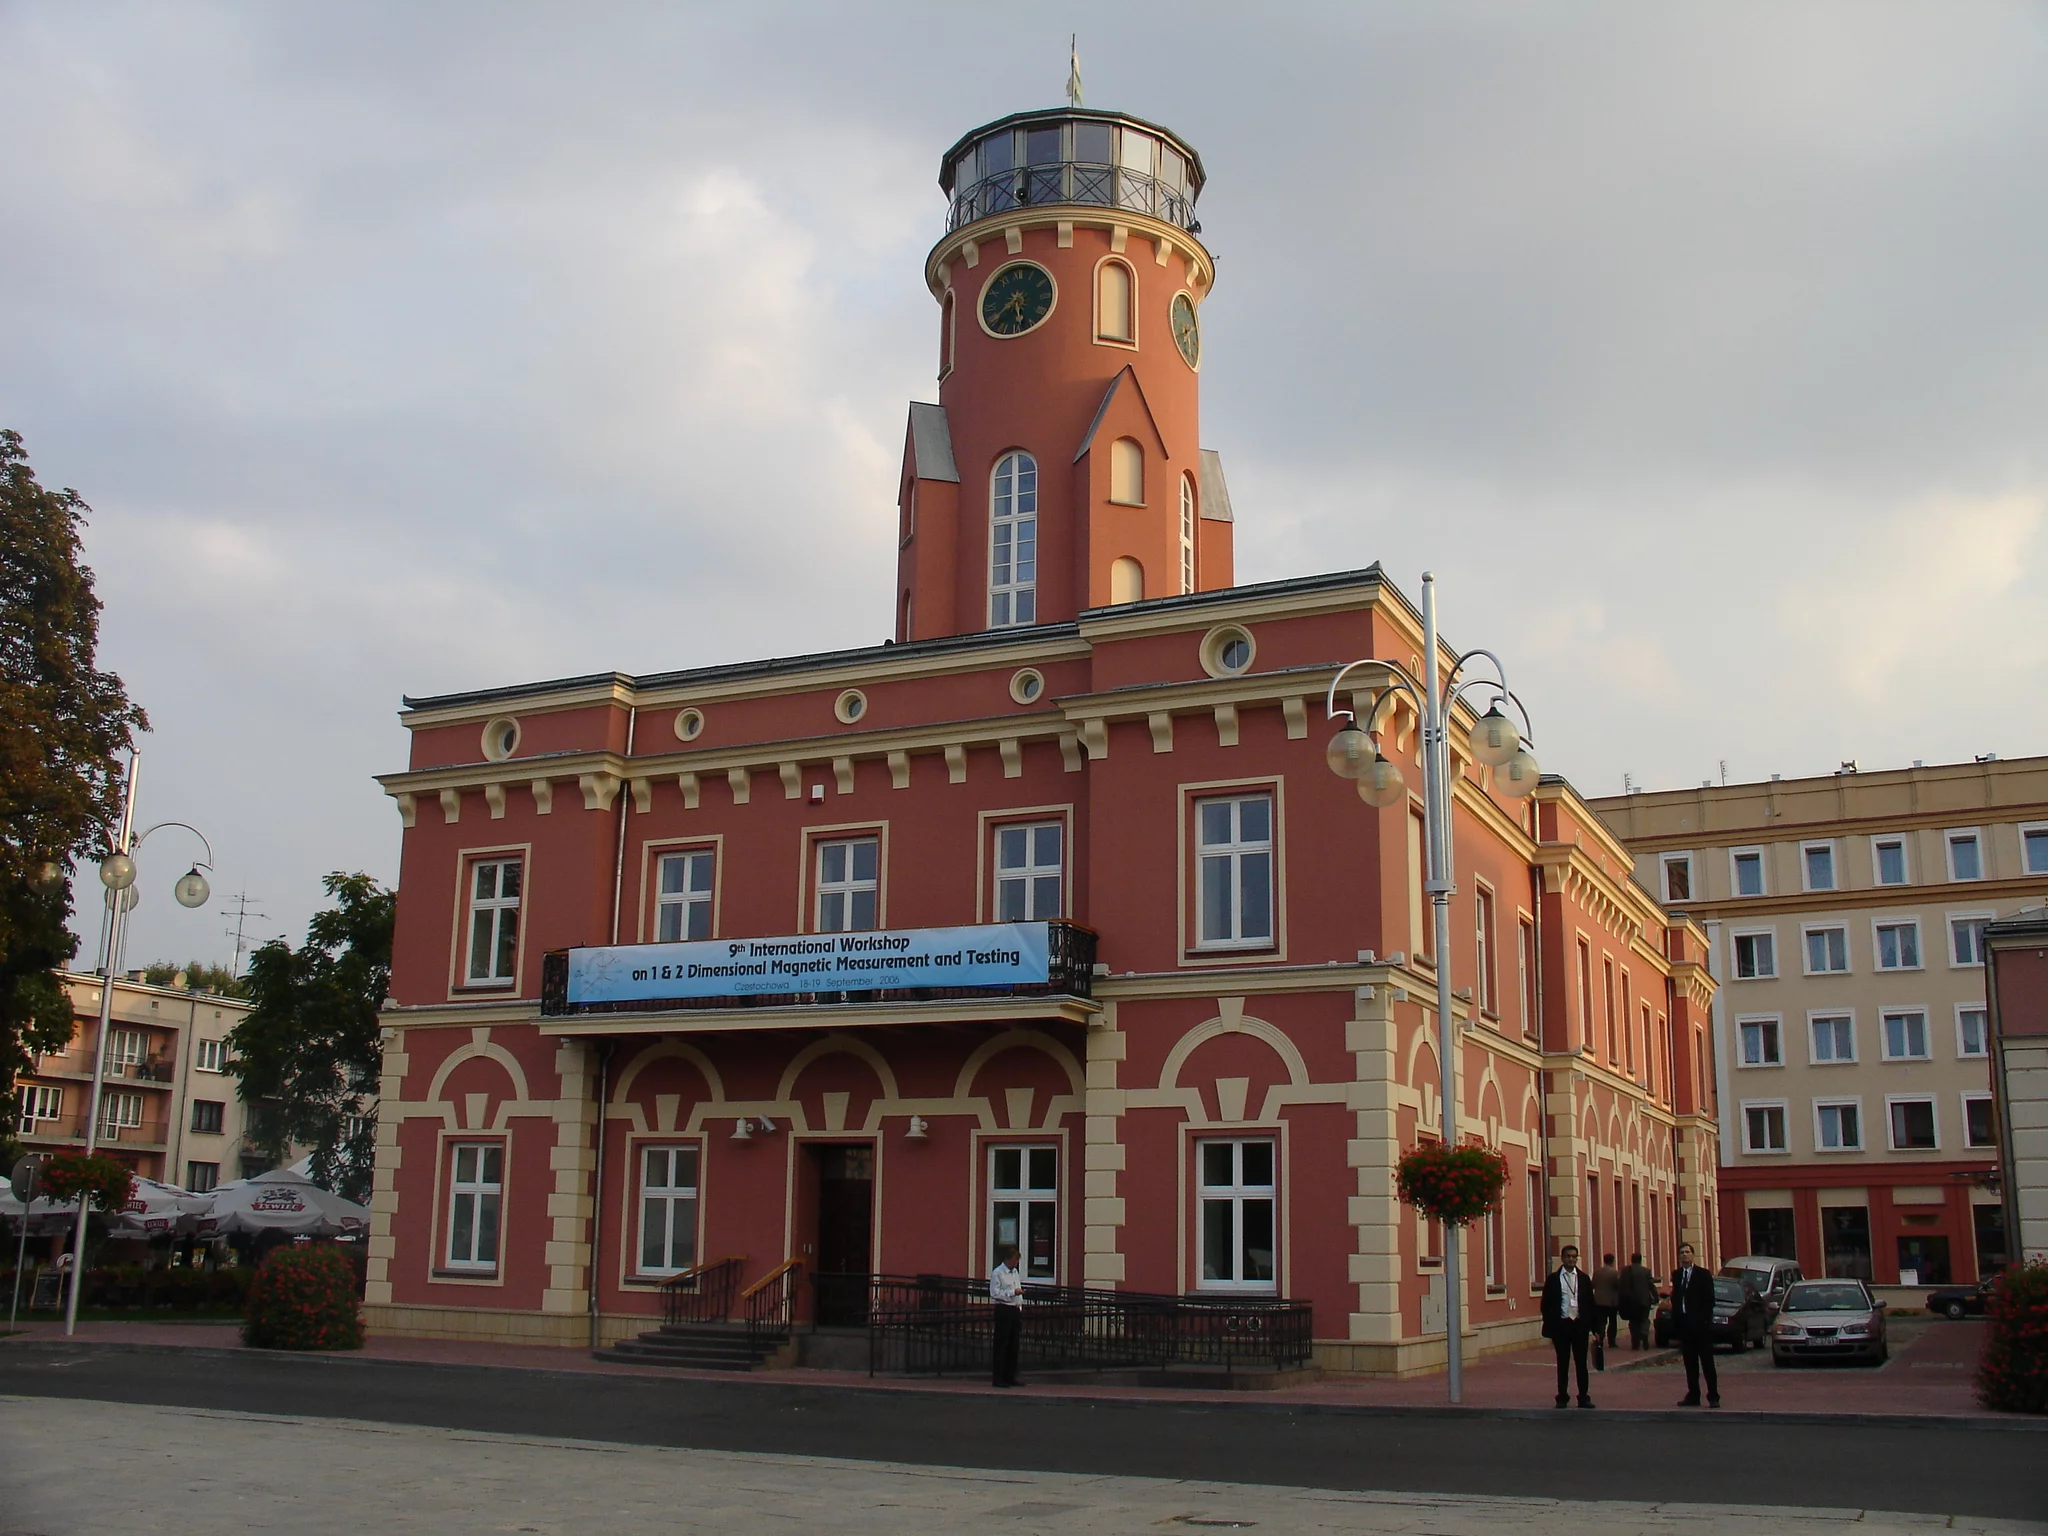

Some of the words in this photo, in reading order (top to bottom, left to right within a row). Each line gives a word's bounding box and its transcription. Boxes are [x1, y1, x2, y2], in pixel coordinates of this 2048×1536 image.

[729, 943, 746, 958] 9th
[750, 938, 835, 957] International
[840, 935, 910, 952] Workshop
[632, 969, 648, 981] on
[651, 966, 657, 980] 1
[661, 965, 672, 979] &
[675, 965, 683, 979] 2
[688, 960, 767, 978] Dimensional
[771, 958, 832, 977] Magnetic
[836, 953, 930, 971] Measurement
[934, 950, 962, 966] and
[966, 948, 1020, 966] Testing
[800, 978, 821, 989] 18-19
[826, 976, 874, 989] September
[879, 975, 900, 985] 2006
